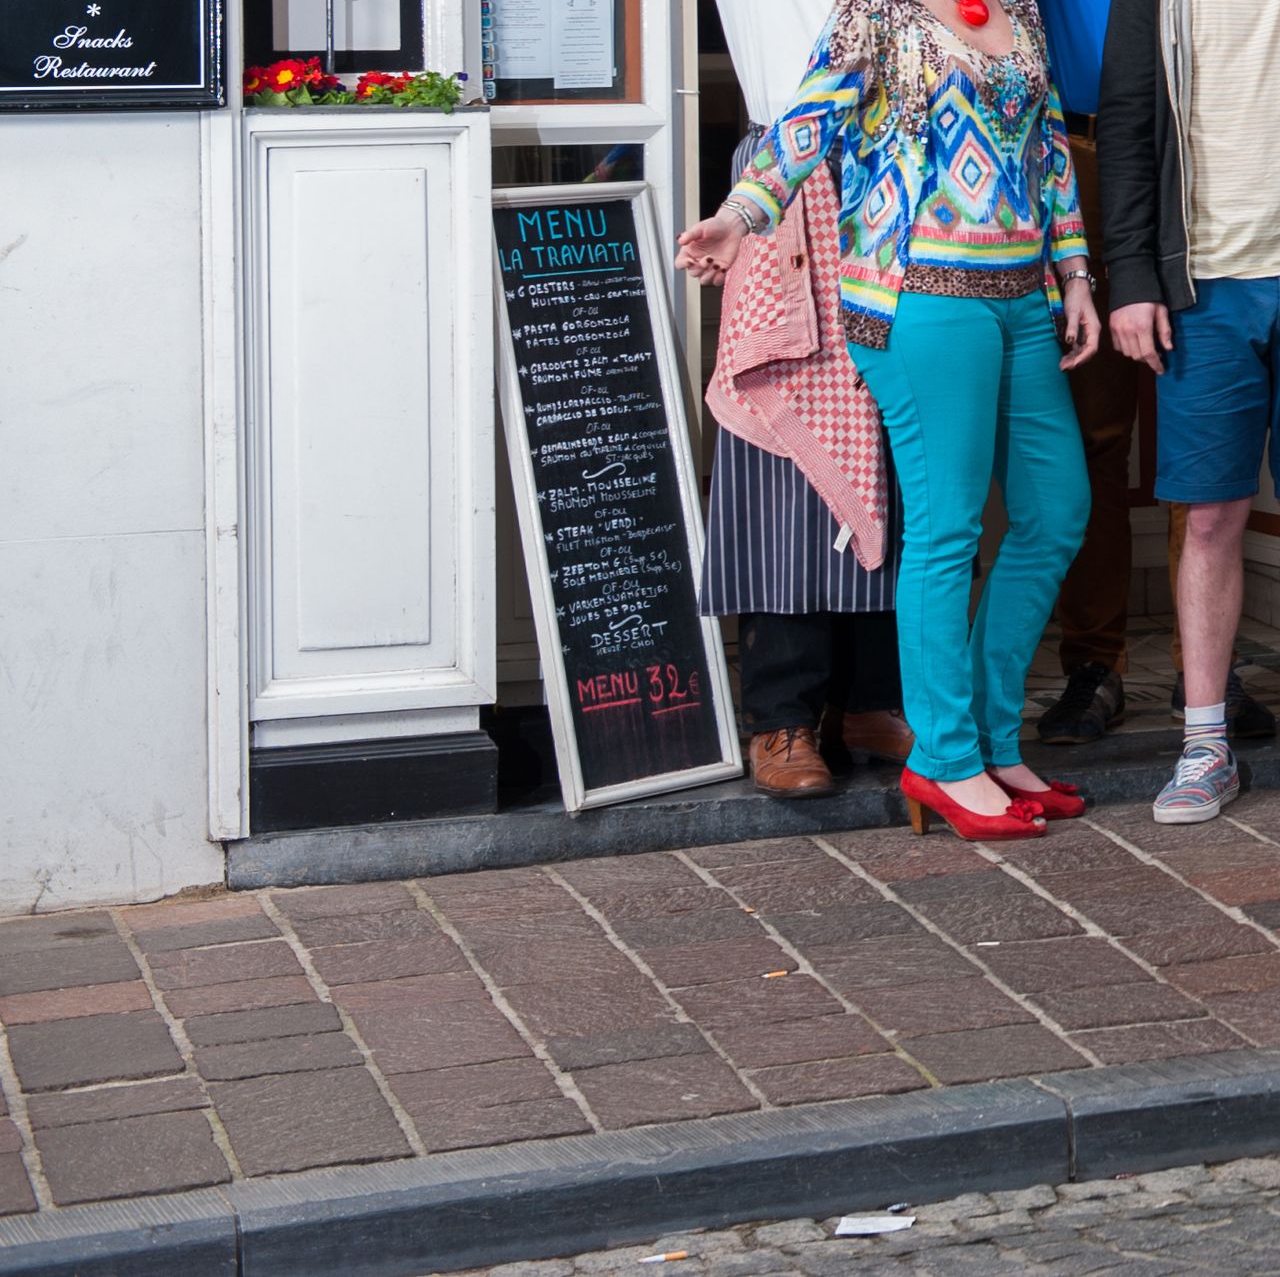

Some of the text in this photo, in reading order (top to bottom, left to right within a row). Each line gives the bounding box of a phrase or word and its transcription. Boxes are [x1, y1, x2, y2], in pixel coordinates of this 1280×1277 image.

[53, 25, 133, 49] Snacks
[33, 55, 157, 80] Restaurant
[517, 209, 608, 242] MENU
[500, 241, 636, 272] LA TRAVIATA
[527, 280, 576, 296] OESTERS
[531, 295, 577, 309] HUITRES
[523, 314, 630, 336] PASTA GORGONZOLA
[526, 328, 631, 349] PATES GORGONZOLA
[530, 359, 580, 375] GEROOKTE
[583, 355, 609, 368] ZALM
[620, 352, 652, 363] TOAST
[536, 412, 582, 427] CARPACCIO
[549, 472, 657, 502] ZALM MOUSSELINE
[550, 495, 596, 513] SAUMON
[556, 524, 594, 541] STEAK
[556, 540, 580, 554] FILET
[562, 577, 587, 589] SOLE
[570, 612, 601, 627] JOUES
[604, 607, 620, 618] DE
[590, 620, 668, 648] DESSERT
[576, 670, 639, 704] MENU
